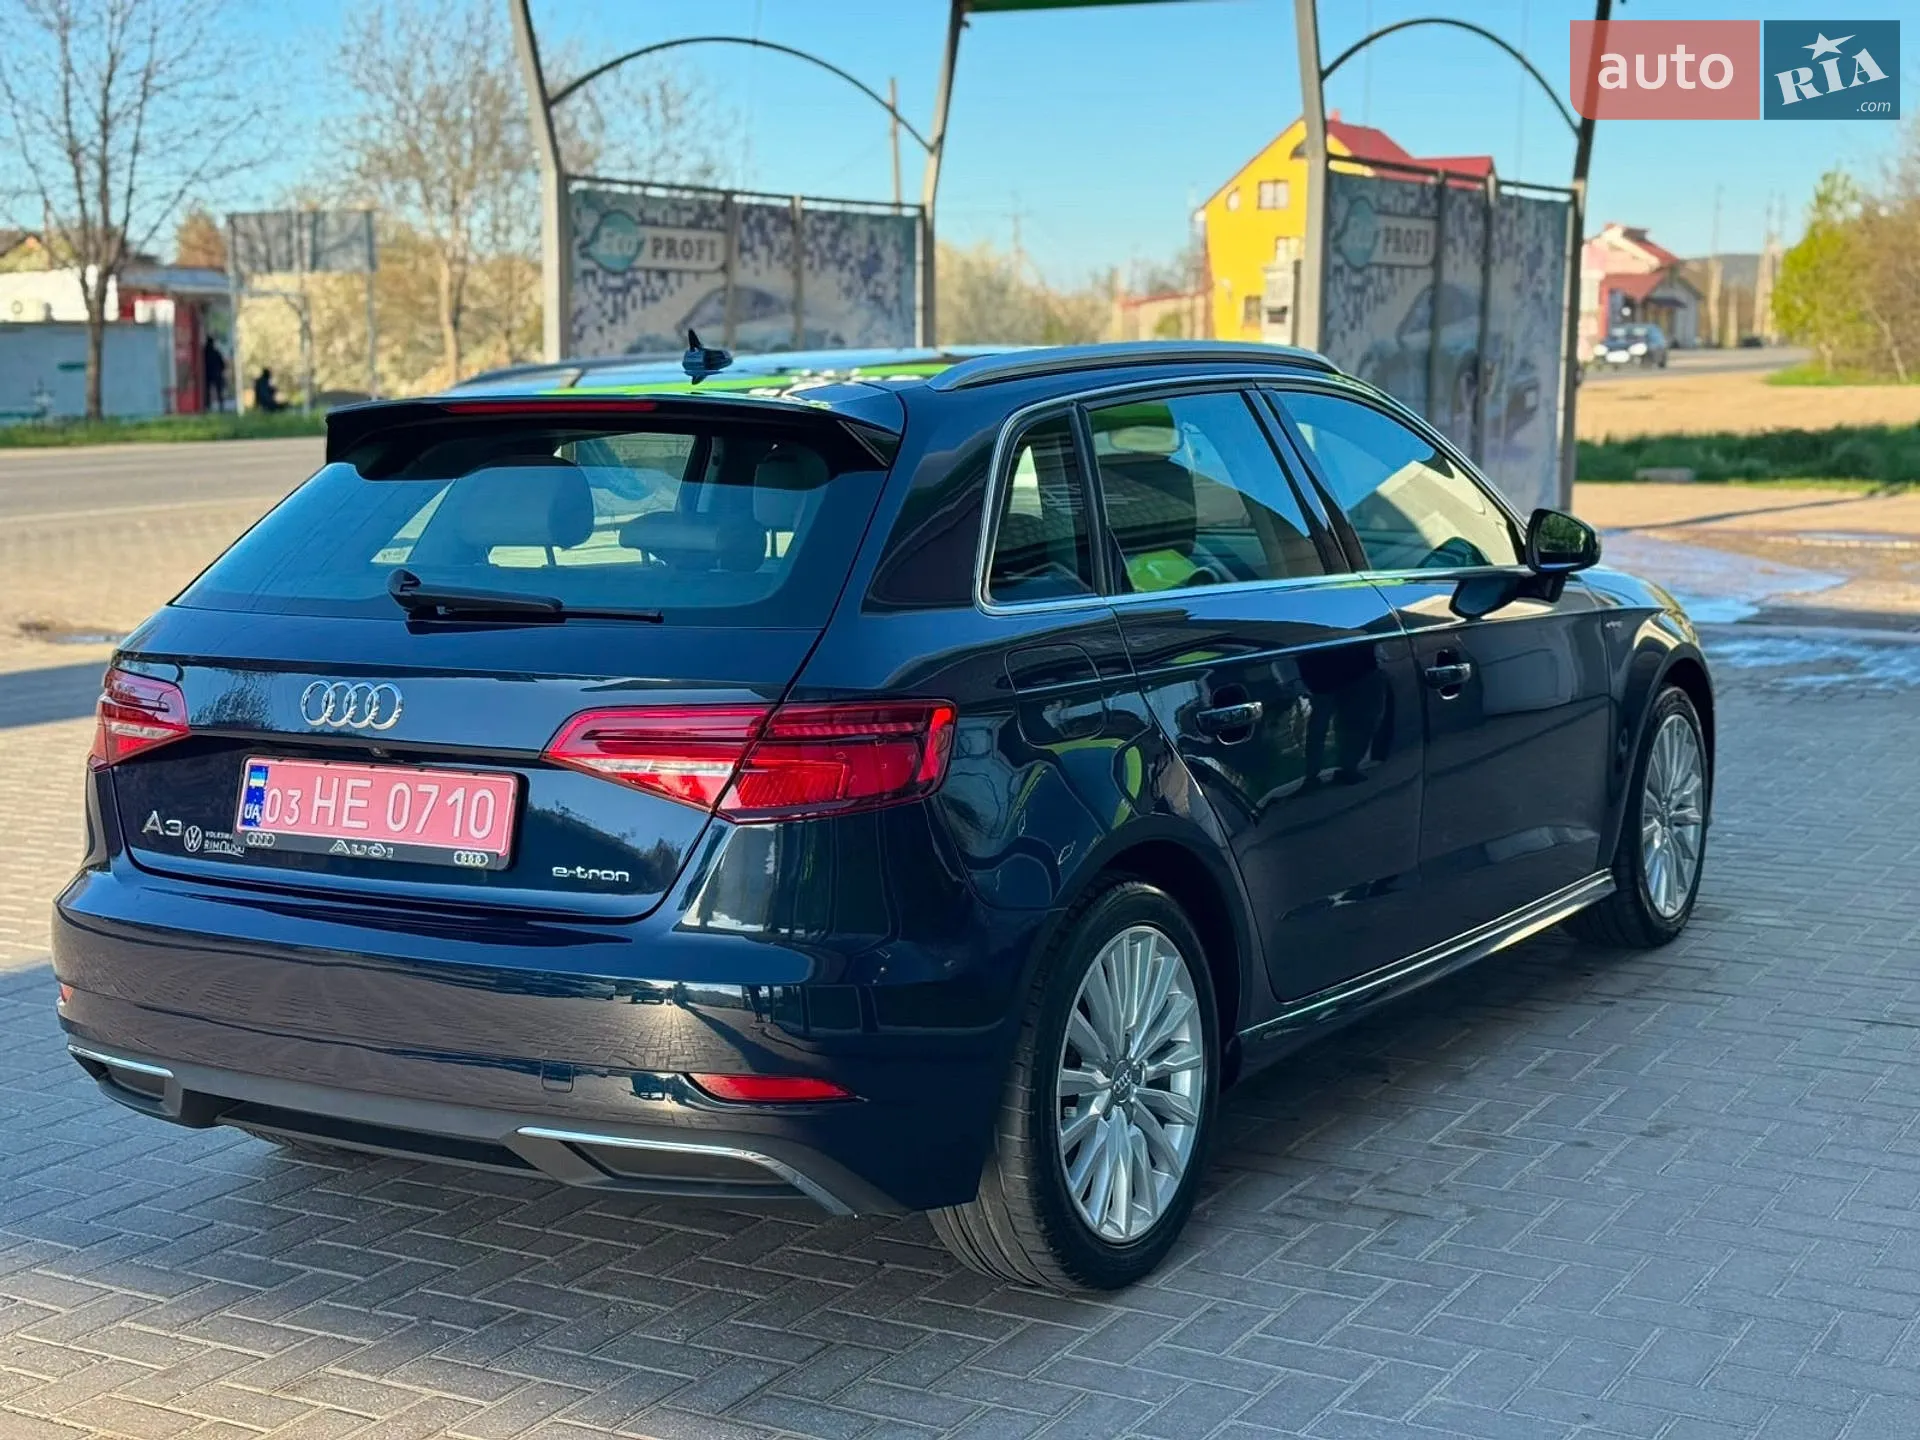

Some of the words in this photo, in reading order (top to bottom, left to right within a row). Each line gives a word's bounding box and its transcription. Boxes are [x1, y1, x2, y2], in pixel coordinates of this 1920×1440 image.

[651, 236, 716, 261] PROFI
[244, 803, 261, 822] UA
[265, 788, 302, 825] 03
[310, 775, 373, 829] HE
[386, 782, 496, 840] 0710
[142, 810, 182, 836] A3
[552, 866, 629, 882] e-tron
